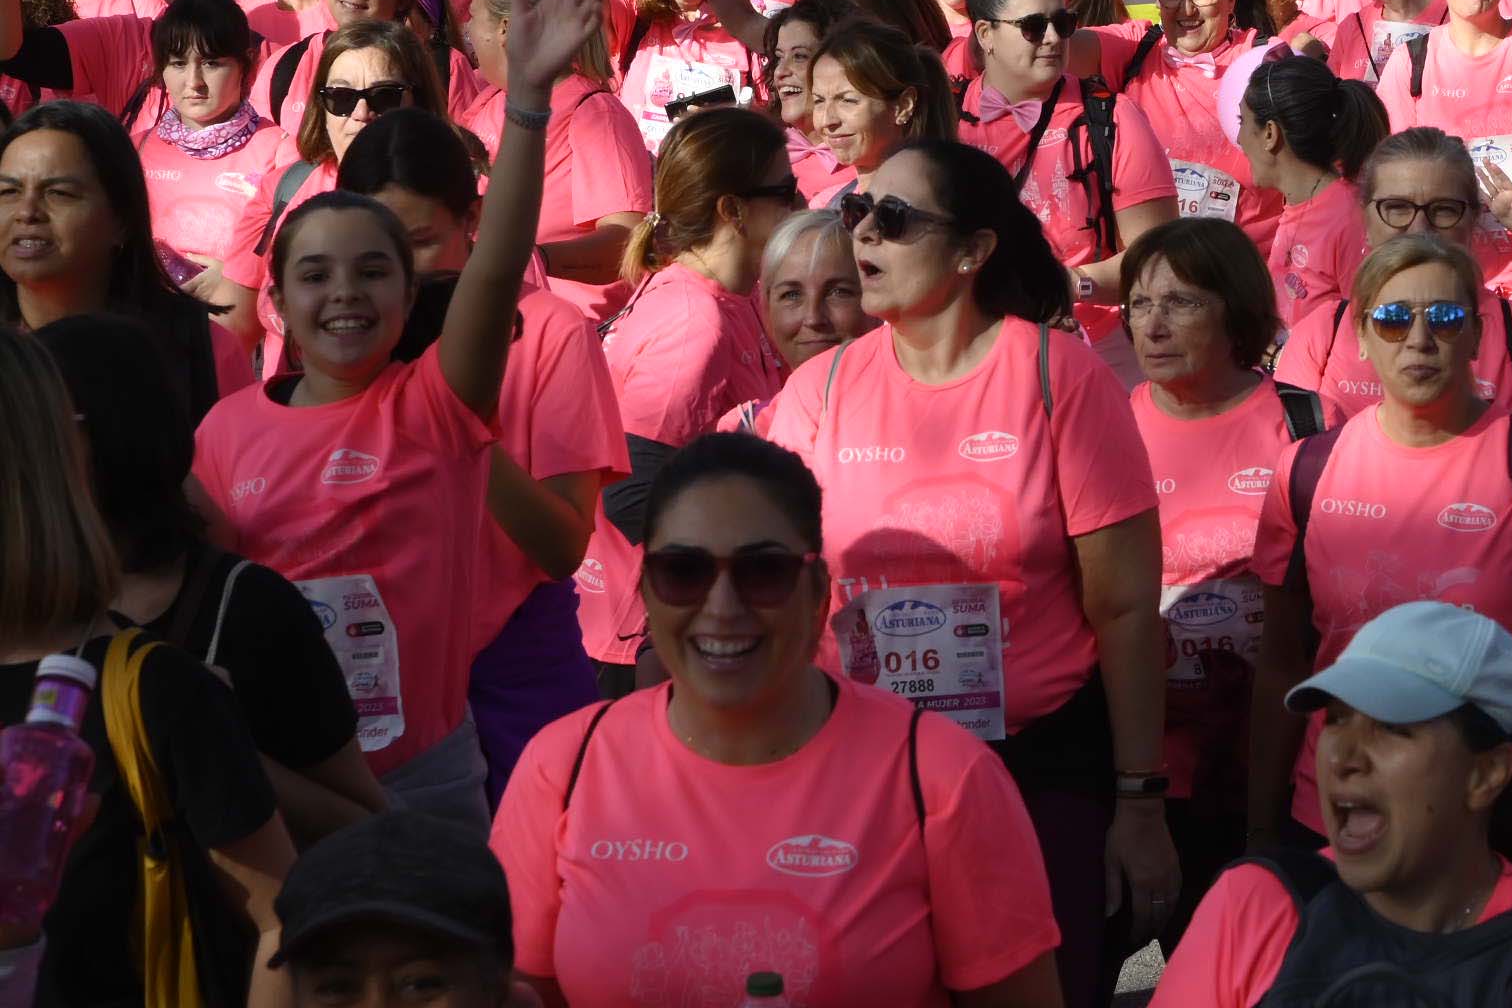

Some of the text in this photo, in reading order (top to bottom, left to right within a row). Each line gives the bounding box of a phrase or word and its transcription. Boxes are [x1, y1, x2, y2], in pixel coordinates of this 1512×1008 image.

[838, 447, 905, 464] OYSHO
[1321, 497, 1387, 518] OYSHO
[344, 598, 381, 611] SUMA
[952, 603, 986, 614] SUMA
[880, 614, 940, 629] ASTURIANA
[884, 648, 941, 674] 016
[891, 678, 935, 694] 27888
[590, 839, 689, 862] OYSHO
